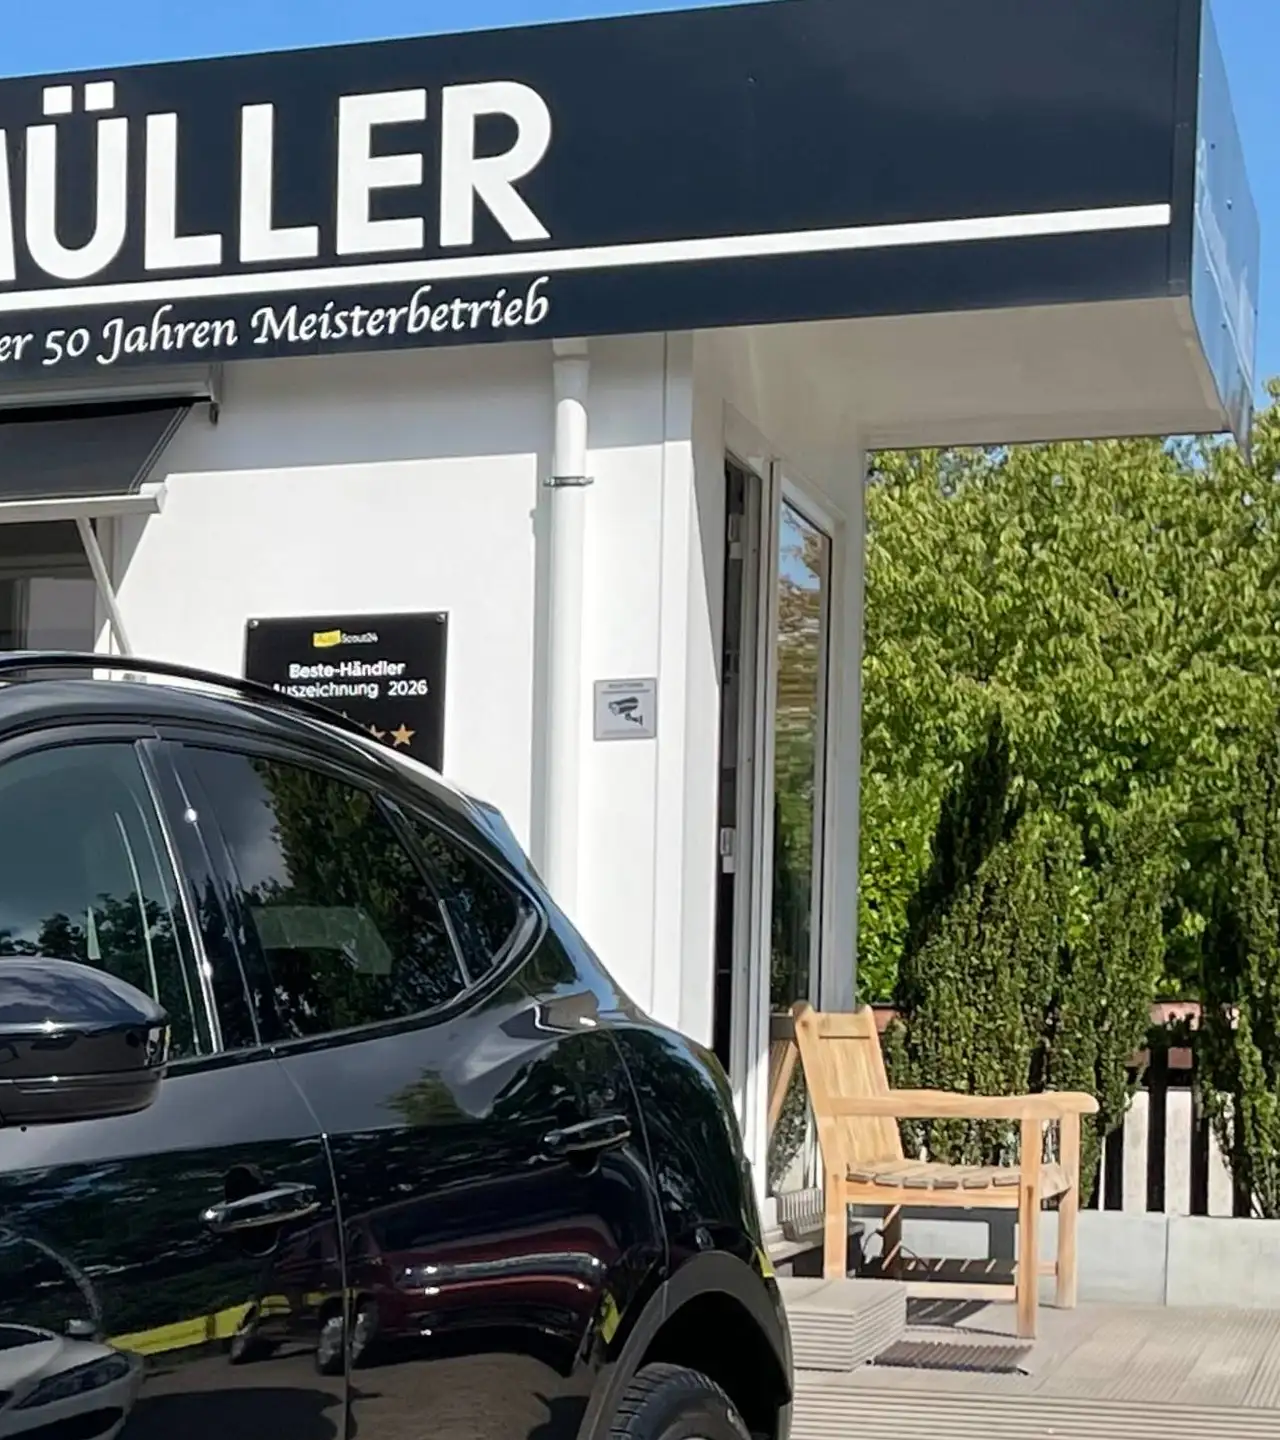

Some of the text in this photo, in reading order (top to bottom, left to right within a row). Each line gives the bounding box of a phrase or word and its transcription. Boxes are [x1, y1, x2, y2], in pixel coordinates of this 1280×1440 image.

[41, 328, 90, 366] 50
[96, 303, 239, 365] Jahren
[251, 276, 550, 345] Meisterbetrieb
[289, 660, 406, 679] Beste-Händler
[387, 679, 428, 696] 2026
